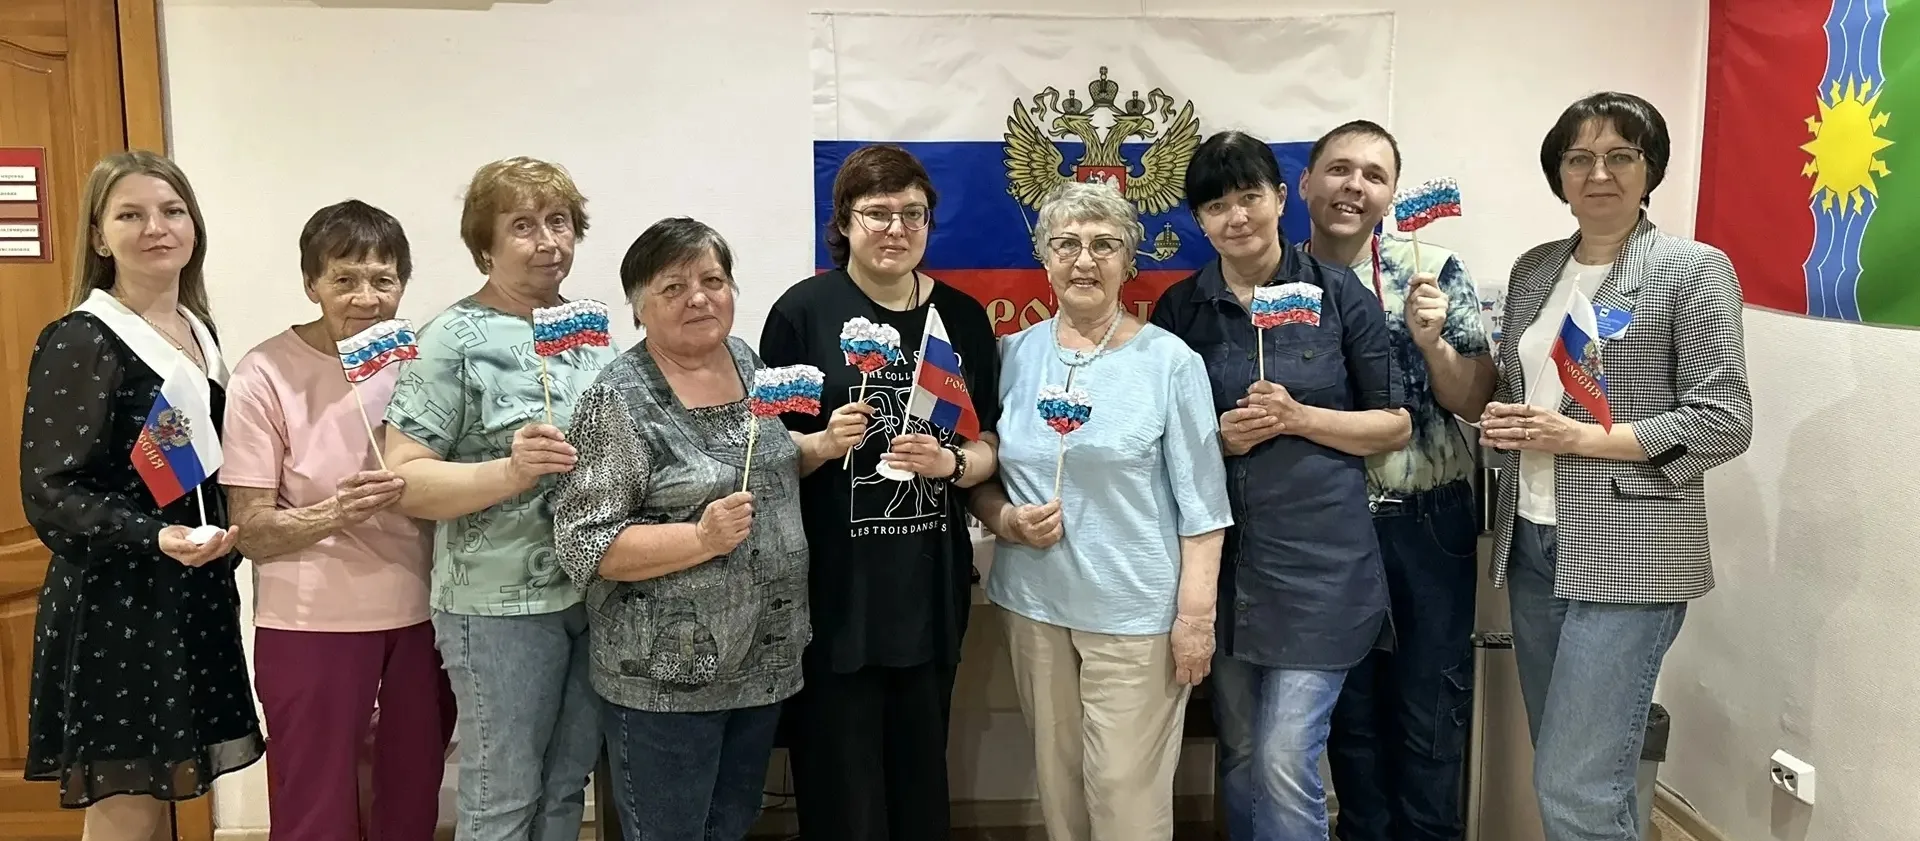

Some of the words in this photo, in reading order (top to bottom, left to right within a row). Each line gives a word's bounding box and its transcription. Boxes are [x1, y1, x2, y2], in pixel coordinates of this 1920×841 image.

[944, 376, 965, 393] РОС
[1564, 359, 1602, 399] РОССИЯ
[850, 526, 869, 538] LES
[872, 525, 908, 535] TROIS
